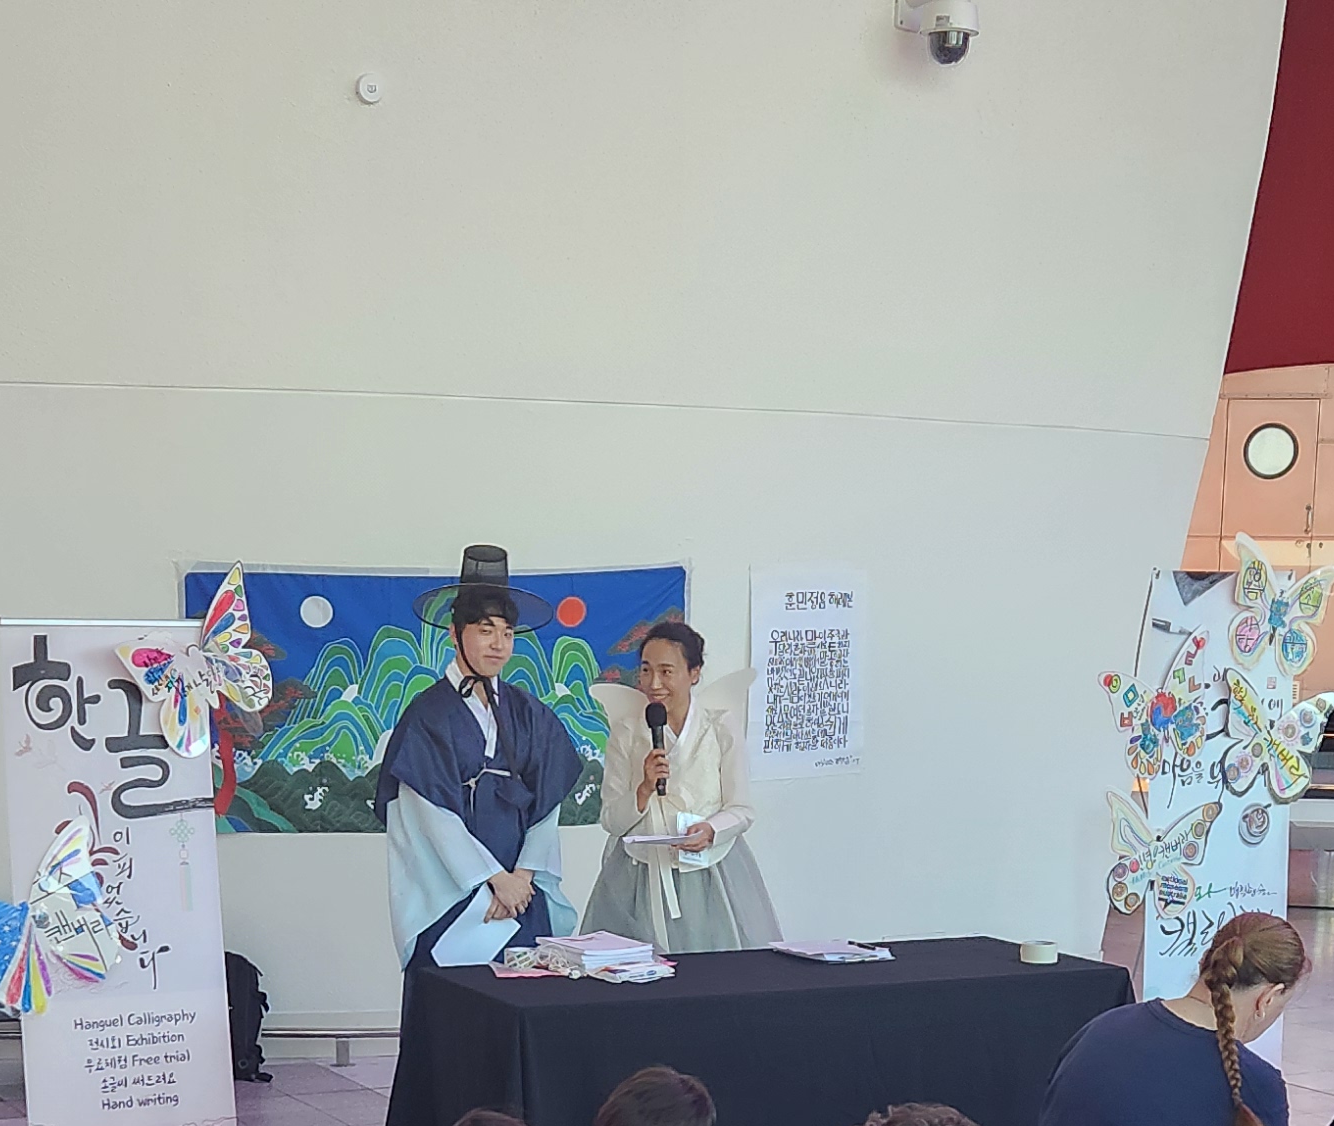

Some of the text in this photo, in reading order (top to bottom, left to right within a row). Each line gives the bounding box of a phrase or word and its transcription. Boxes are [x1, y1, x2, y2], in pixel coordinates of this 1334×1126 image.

[73, 1009, 197, 1032] Hanguel Calligraphy
[87, 1030, 185, 1051] 전시회 Exhibition
[84, 1049, 191, 1074] 무료체험 Free trial
[101, 1092, 180, 1111] Hand writing
